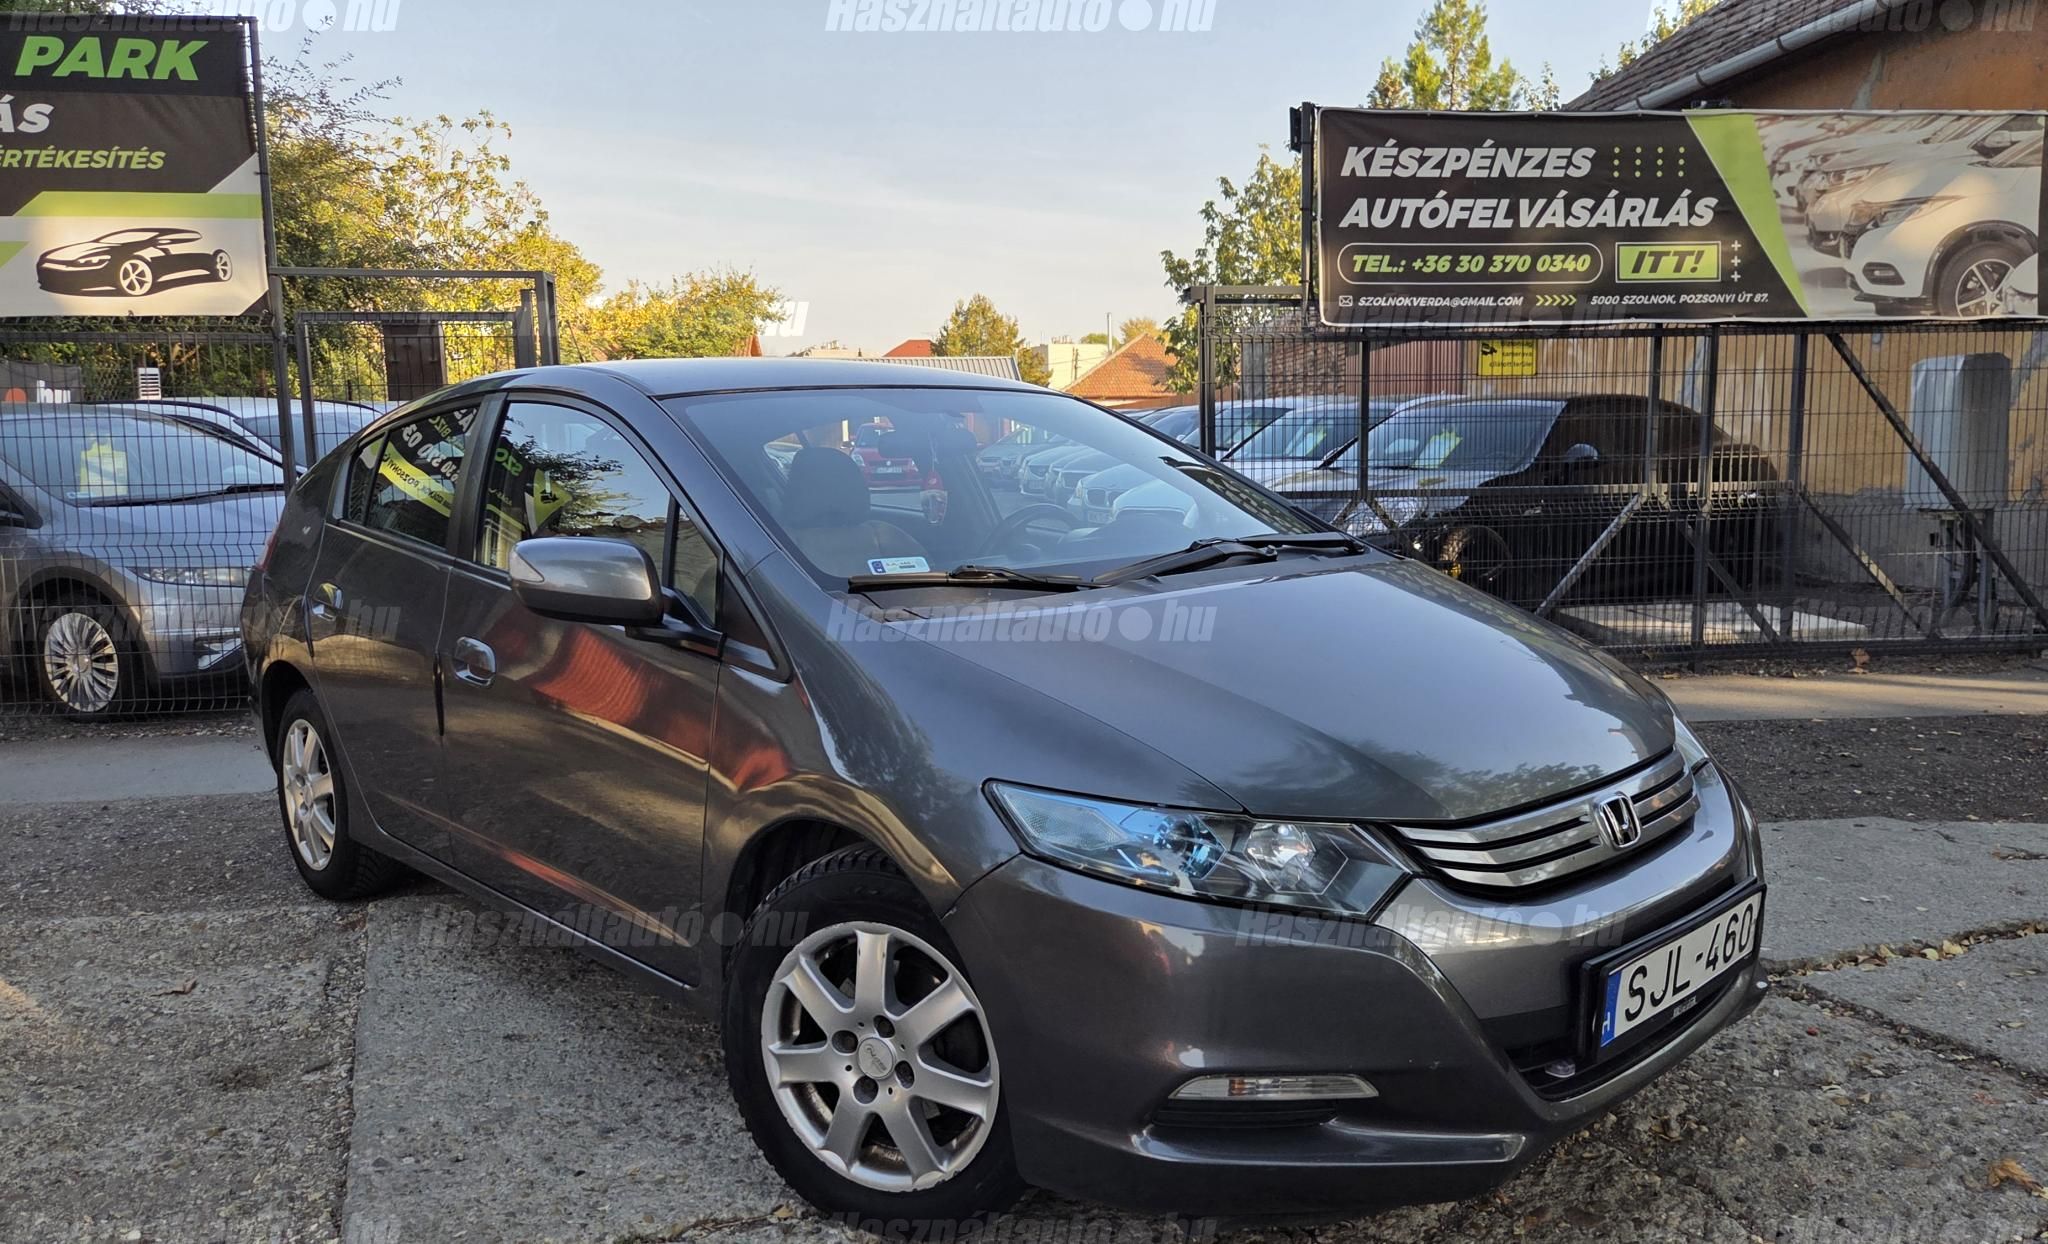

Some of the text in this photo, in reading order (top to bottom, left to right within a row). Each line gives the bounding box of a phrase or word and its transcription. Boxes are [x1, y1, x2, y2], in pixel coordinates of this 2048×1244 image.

[15, 35, 208, 81] PARK
[1340, 139, 1596, 178] KÉSZPÉNZES
[1339, 189, 1719, 229] AUTÓFELVÁSÁRLÁS
[1352, 253, 1592, 273] TEL.: +36 30 370 0340
[1631, 250, 1705, 274] ITT!
[1358, 296, 1524, 308] SZOLNOKVERDA@GMAIL.COM
[1590, 291, 1769, 305] 5000 SZOLNOK, POZSONYI ÚT 87.
[1624, 903, 1754, 1022] SJL-460
